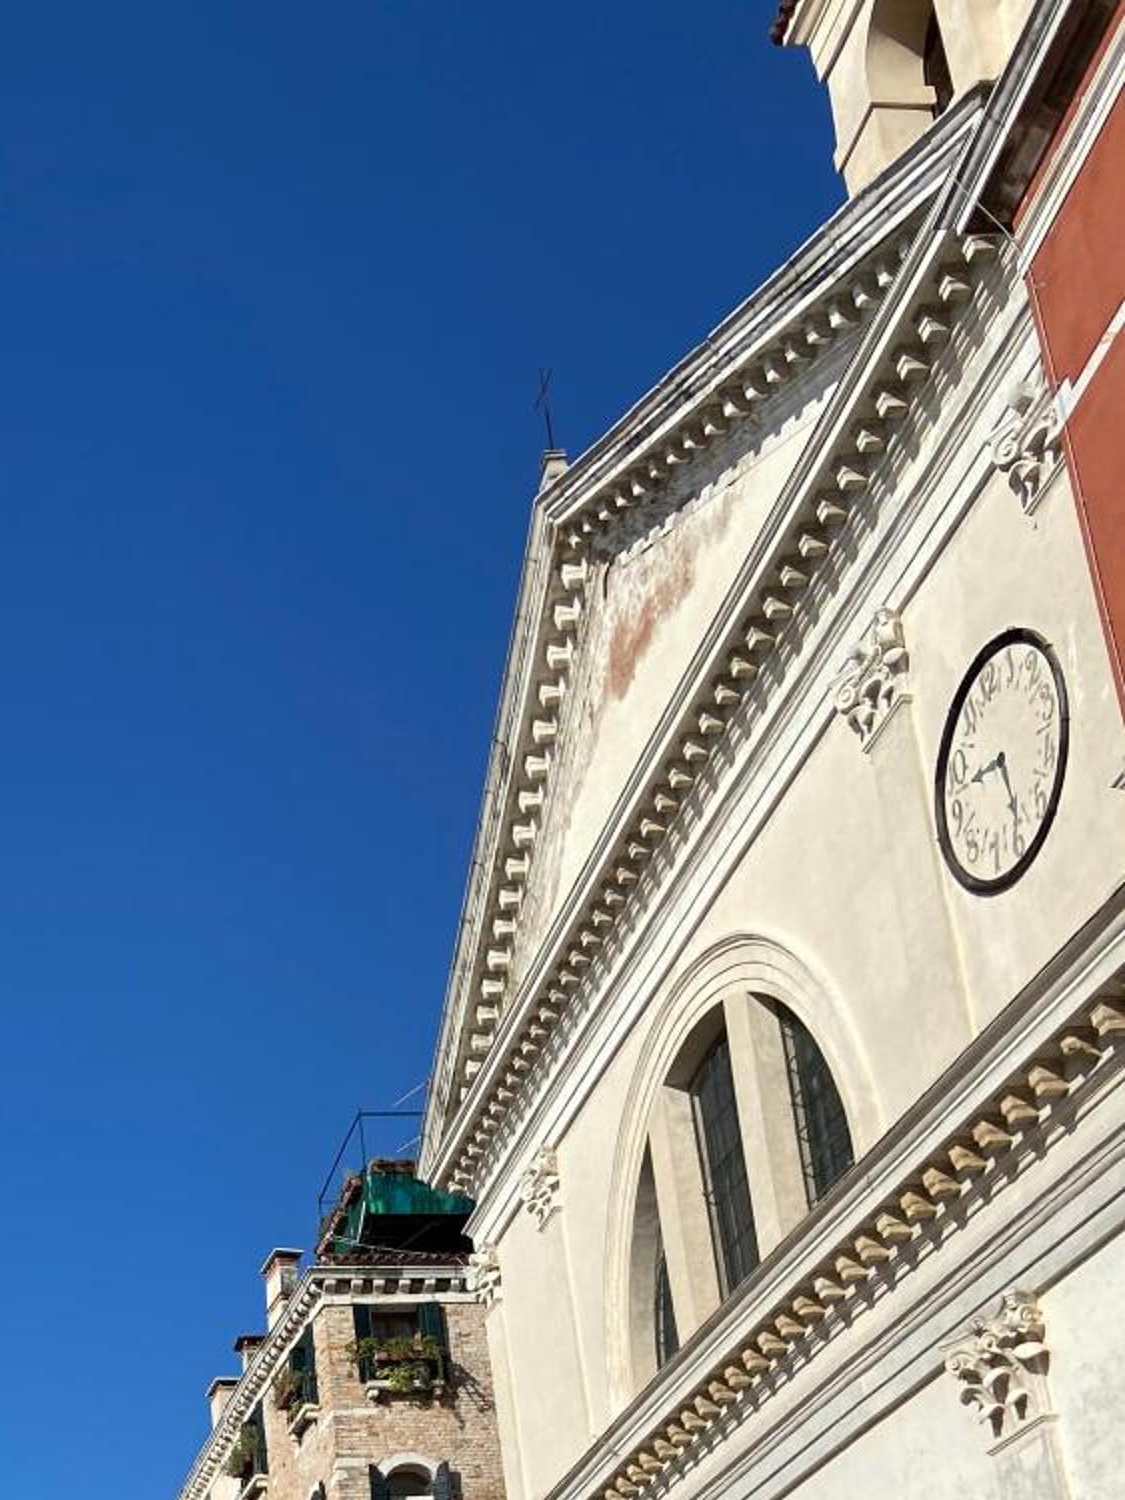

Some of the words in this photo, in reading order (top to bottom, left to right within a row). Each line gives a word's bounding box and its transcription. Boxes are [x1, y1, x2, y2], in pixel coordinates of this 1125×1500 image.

[1025, 649, 1041, 691] 2
[1038, 682, 1055, 720] 3
[952, 799, 963, 837] 9
[966, 828, 979, 862] 8
